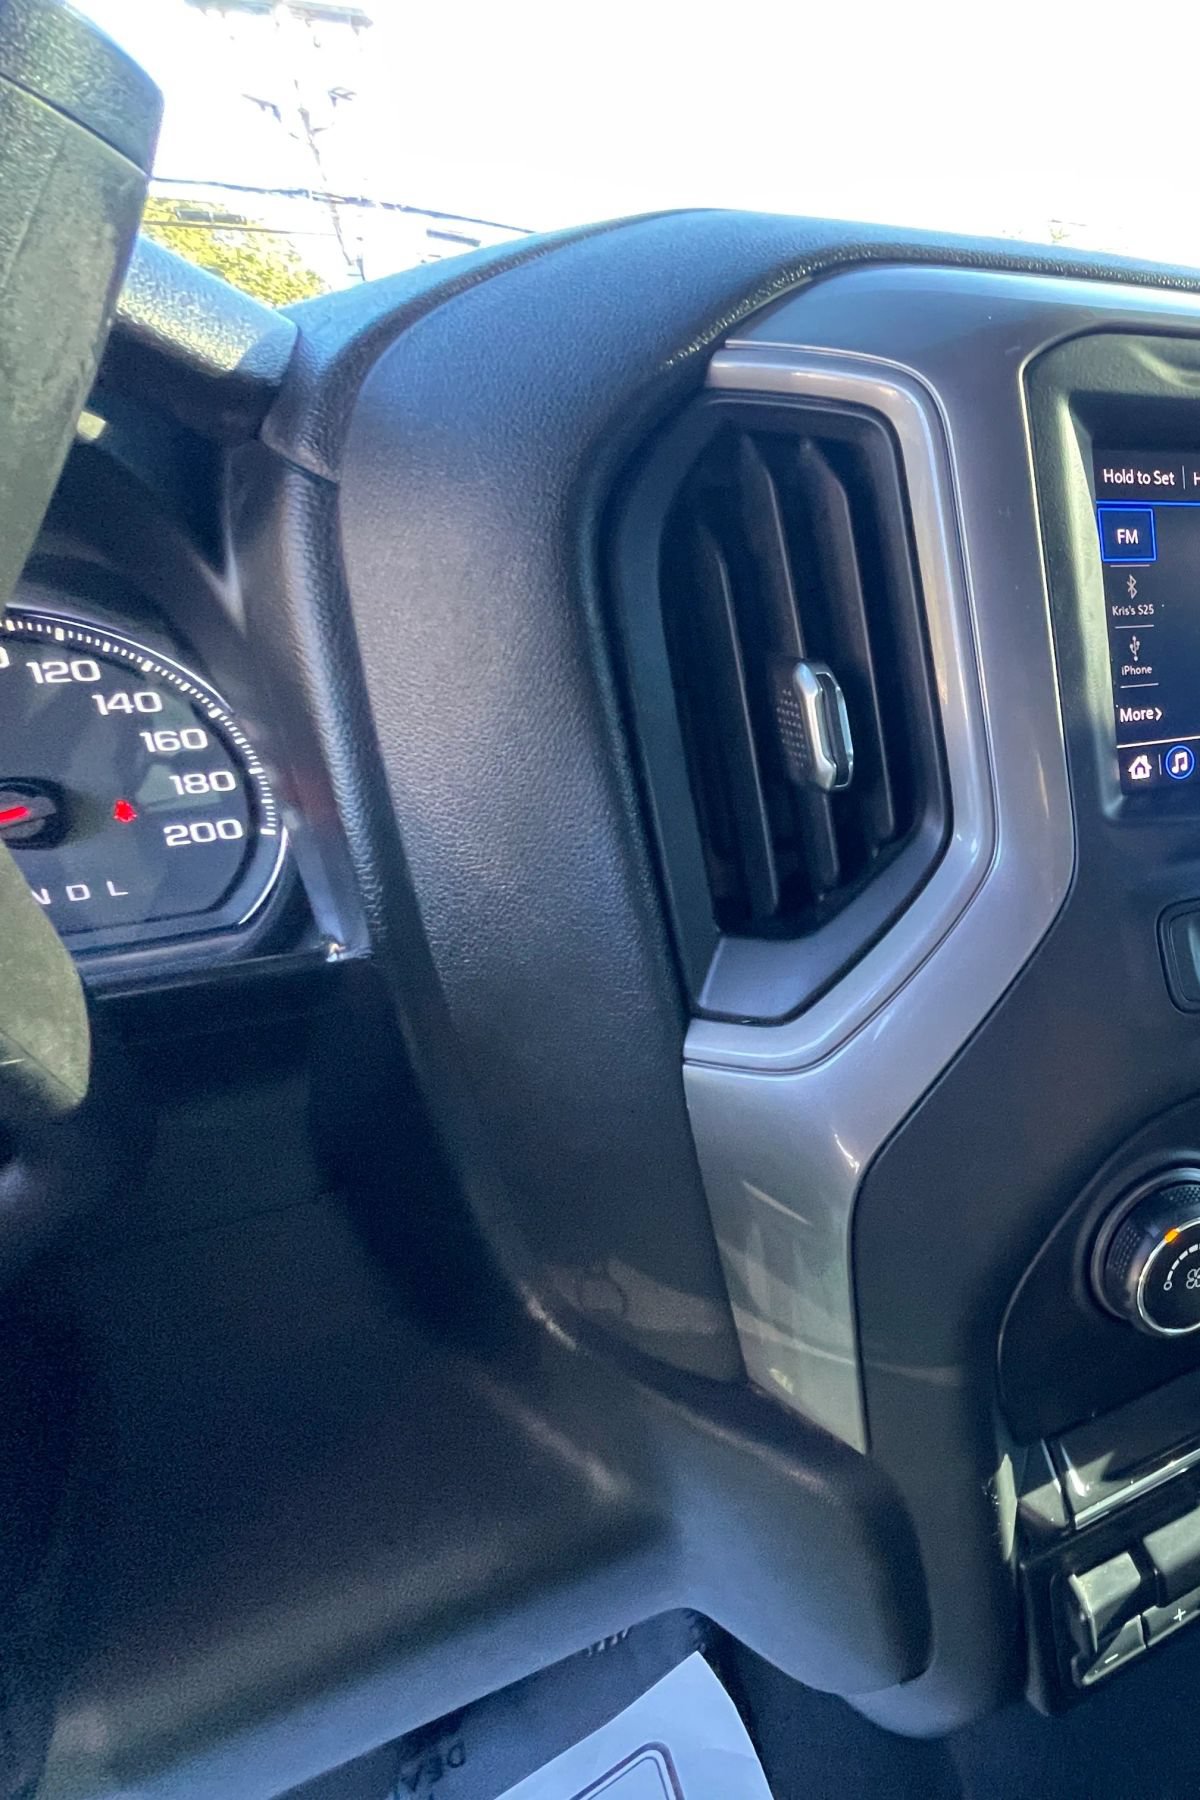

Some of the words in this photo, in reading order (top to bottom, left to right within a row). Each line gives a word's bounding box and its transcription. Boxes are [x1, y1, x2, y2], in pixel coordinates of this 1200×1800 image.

[1103, 468, 1134, 484] Hold
[1137, 472, 1151, 485] to
[1153, 470, 1175, 486] Set
[1117, 529, 1139, 545] FM
[1112, 605, 1136, 616] Kris's
[1138, 604, 1154, 615] S25
[27, 660, 101, 684] 120
[1121, 665, 1152, 676] iPhone
[92, 692, 163, 715] 140
[1120, 707, 1154, 723] More
[140, 728, 208, 752] 160
[169, 770, 236, 795] 180
[164, 819, 243, 846] 200
[66, 884, 90, 901] D
[107, 880, 129, 897] L
